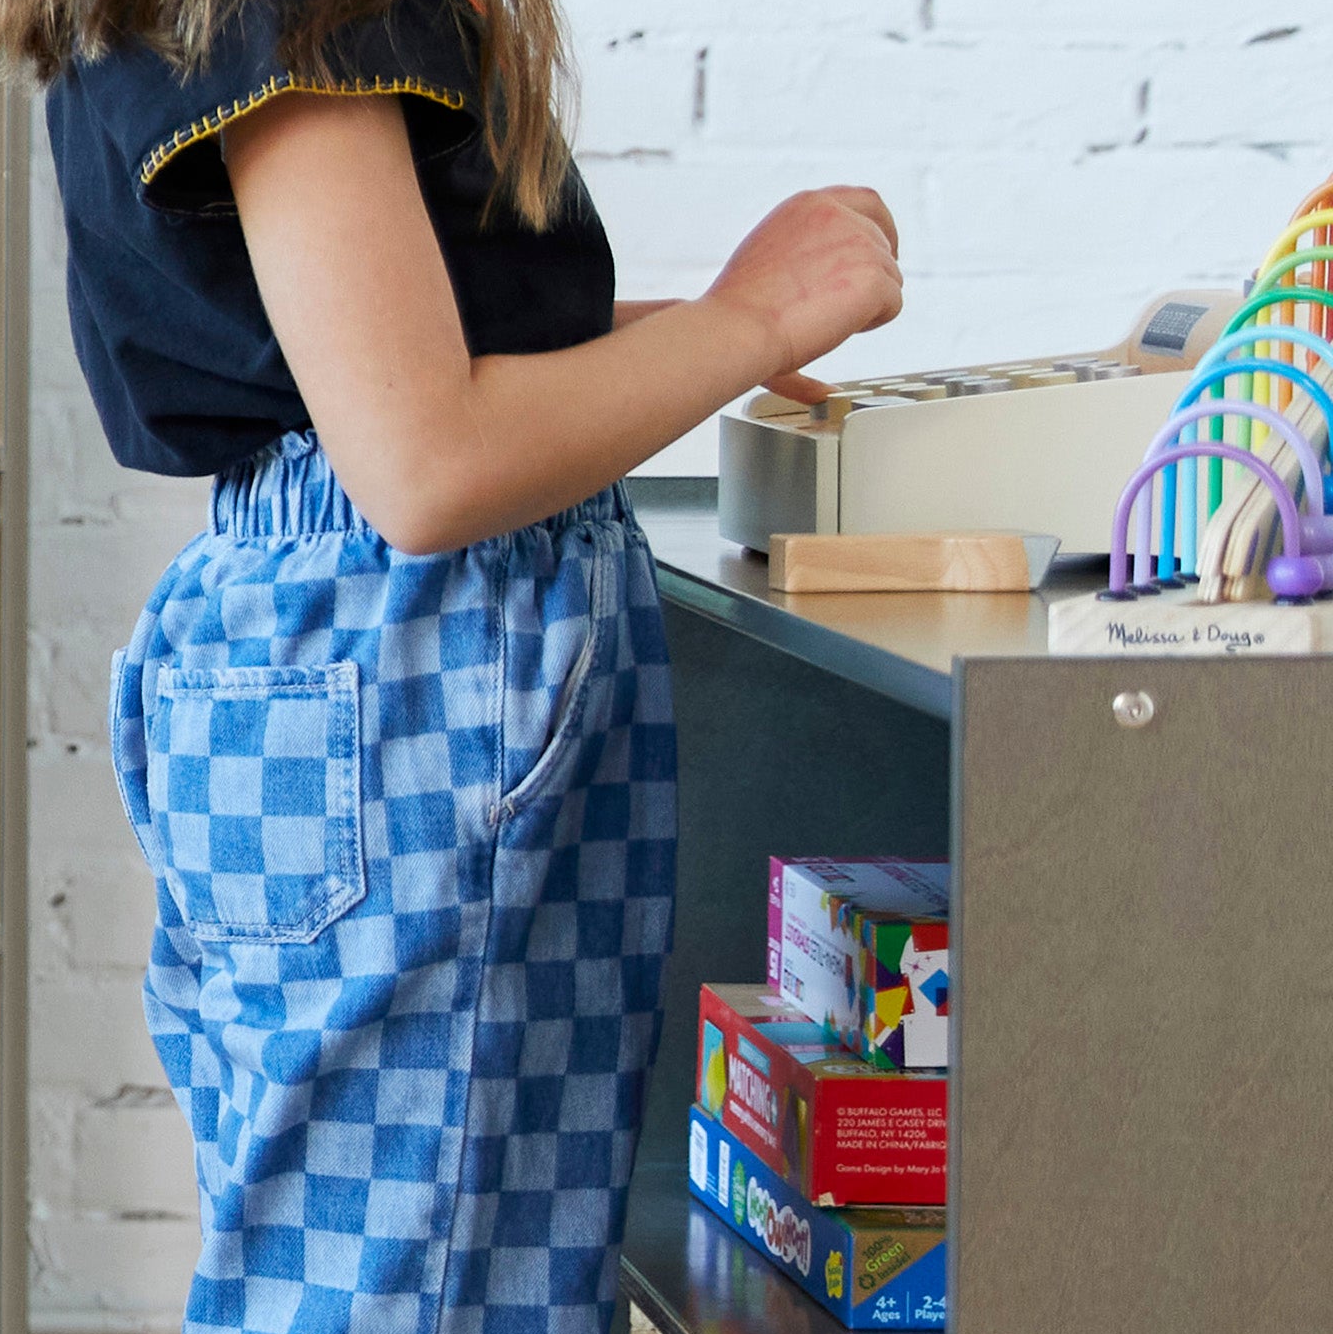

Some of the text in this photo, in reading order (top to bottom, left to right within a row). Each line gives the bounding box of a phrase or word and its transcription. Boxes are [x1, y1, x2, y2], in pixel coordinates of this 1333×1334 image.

[1108, 621, 1183, 647] Melissa
[847, 1107, 887, 1116] BUFFALO
[857, 1118, 886, 1127] JAMES
[895, 1118, 925, 1127] CASEY
[881, 1130, 895, 1138] NY
[898, 1130, 927, 1138] 14206
[836, 1140, 946, 1150] MADE IN CHINA/FABRIQ
[836, 1164, 862, 1173] Game
[864, 1164, 892, 1175] Design
[894, 1165, 905, 1175] by
[907, 1165, 930, 1175] Mary
[931, 1166, 941, 1174] Jo
[865, 1242, 904, 1273] Green
[875, 1295, 897, 1309] 4+
[872, 1309, 901, 1323] Ages
[914, 1308, 946, 1322] Playe
